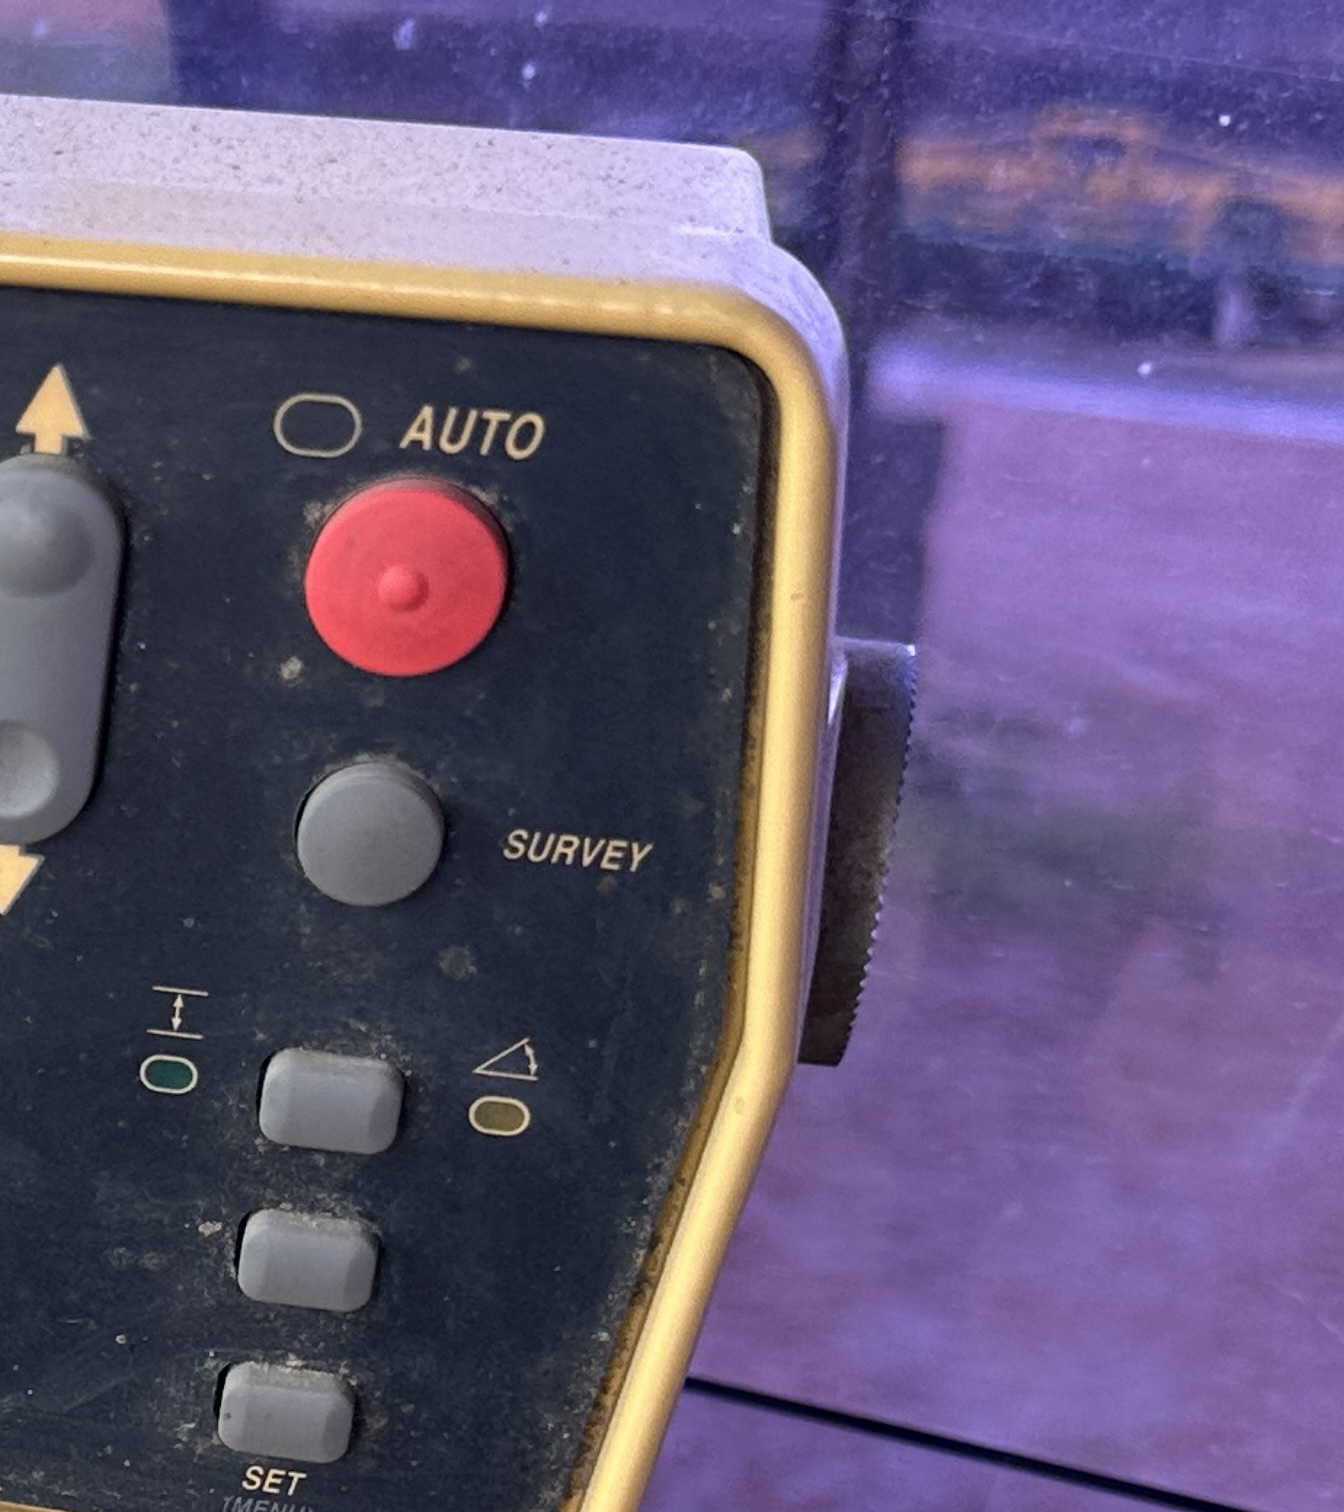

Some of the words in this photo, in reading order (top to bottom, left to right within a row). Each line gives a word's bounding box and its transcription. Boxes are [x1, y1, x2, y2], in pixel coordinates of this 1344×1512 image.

[399, 405, 546, 460] AUTO
[502, 829, 654, 874] SURVEY
[241, 1466, 308, 1497] SET
